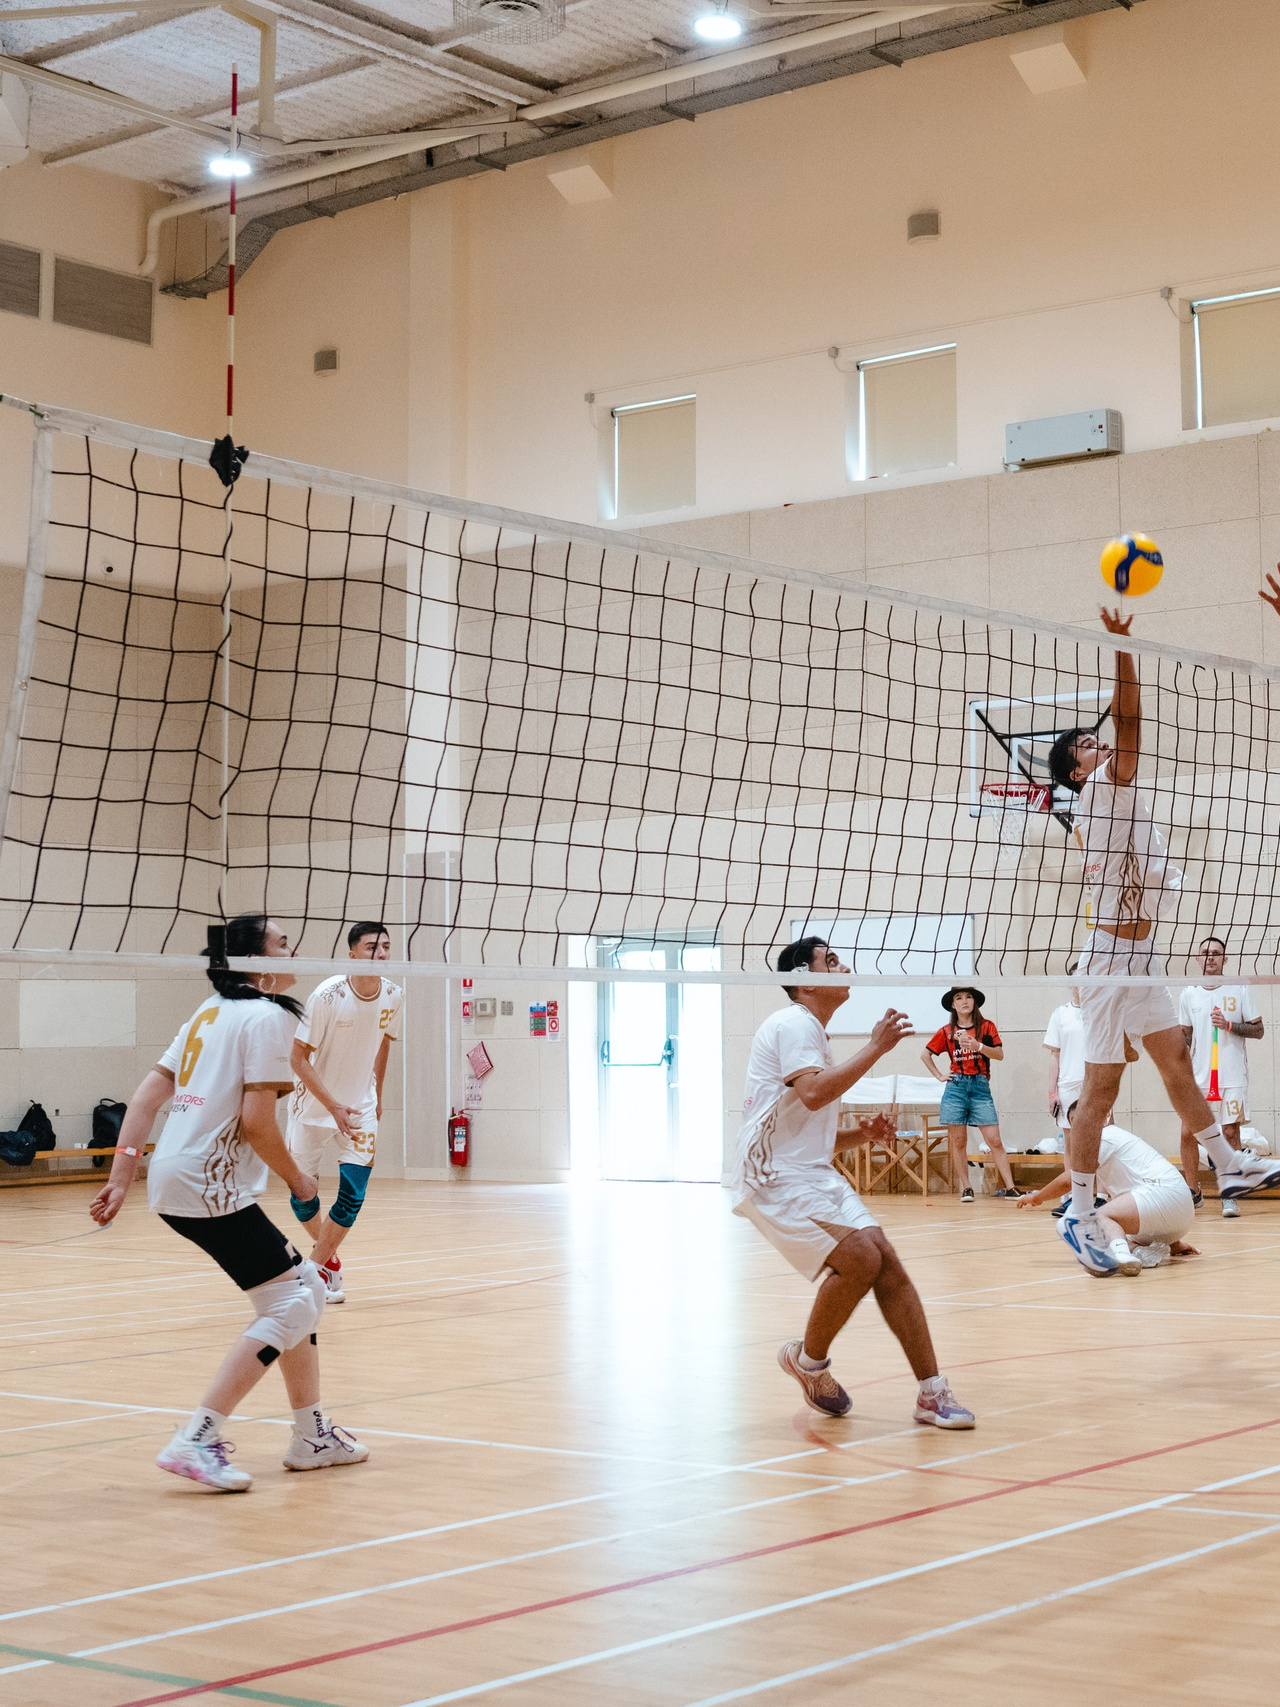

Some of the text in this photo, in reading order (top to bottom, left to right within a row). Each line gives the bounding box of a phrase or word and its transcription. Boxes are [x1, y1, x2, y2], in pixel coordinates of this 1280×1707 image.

[1222, 996, 1237, 1012] 13
[178, 1006, 220, 1087] 6
[1226, 1100, 1240, 1117] 13
[354, 1131, 376, 1154] 23
